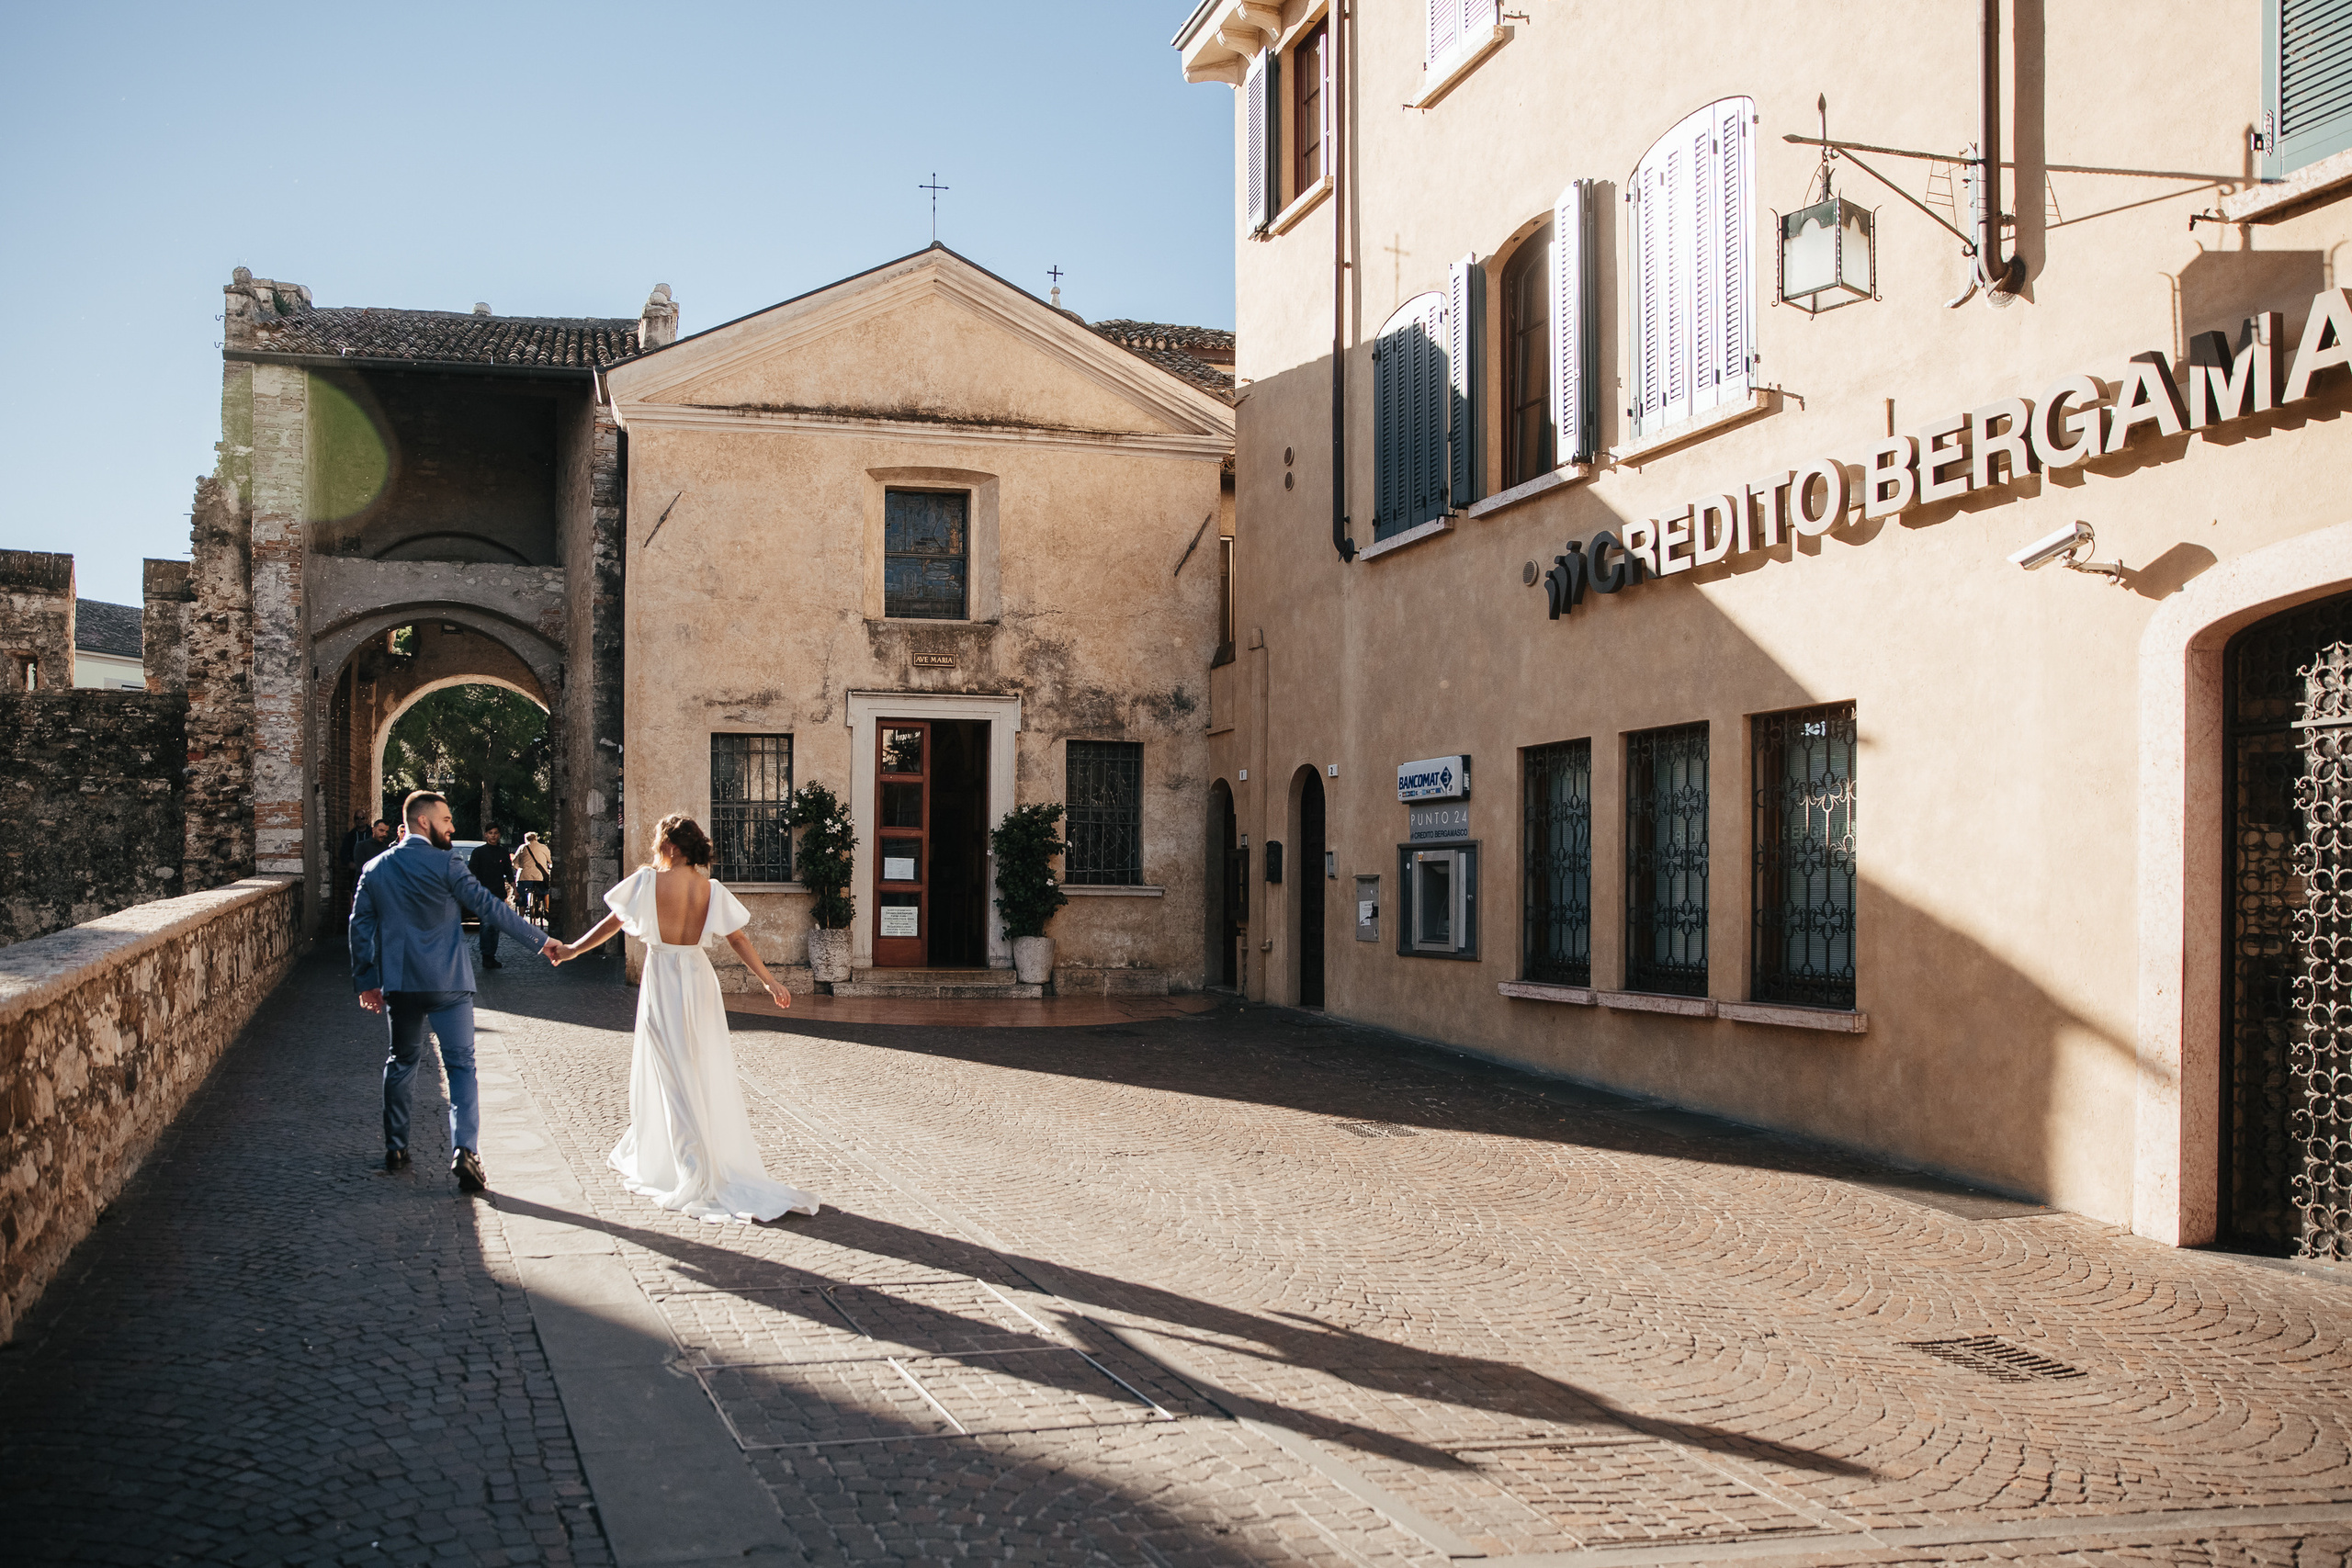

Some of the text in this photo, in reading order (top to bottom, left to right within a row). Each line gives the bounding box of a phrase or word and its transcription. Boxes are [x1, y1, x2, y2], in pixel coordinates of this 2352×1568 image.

[1587, 287, 2352, 593] CREDITO BERGAMA
[1398, 772, 1440, 790] BANCOMAT
[1410, 810, 1467, 826] PUNTO 24
[1414, 829, 1468, 840] CREDITO BERGAMASCO
